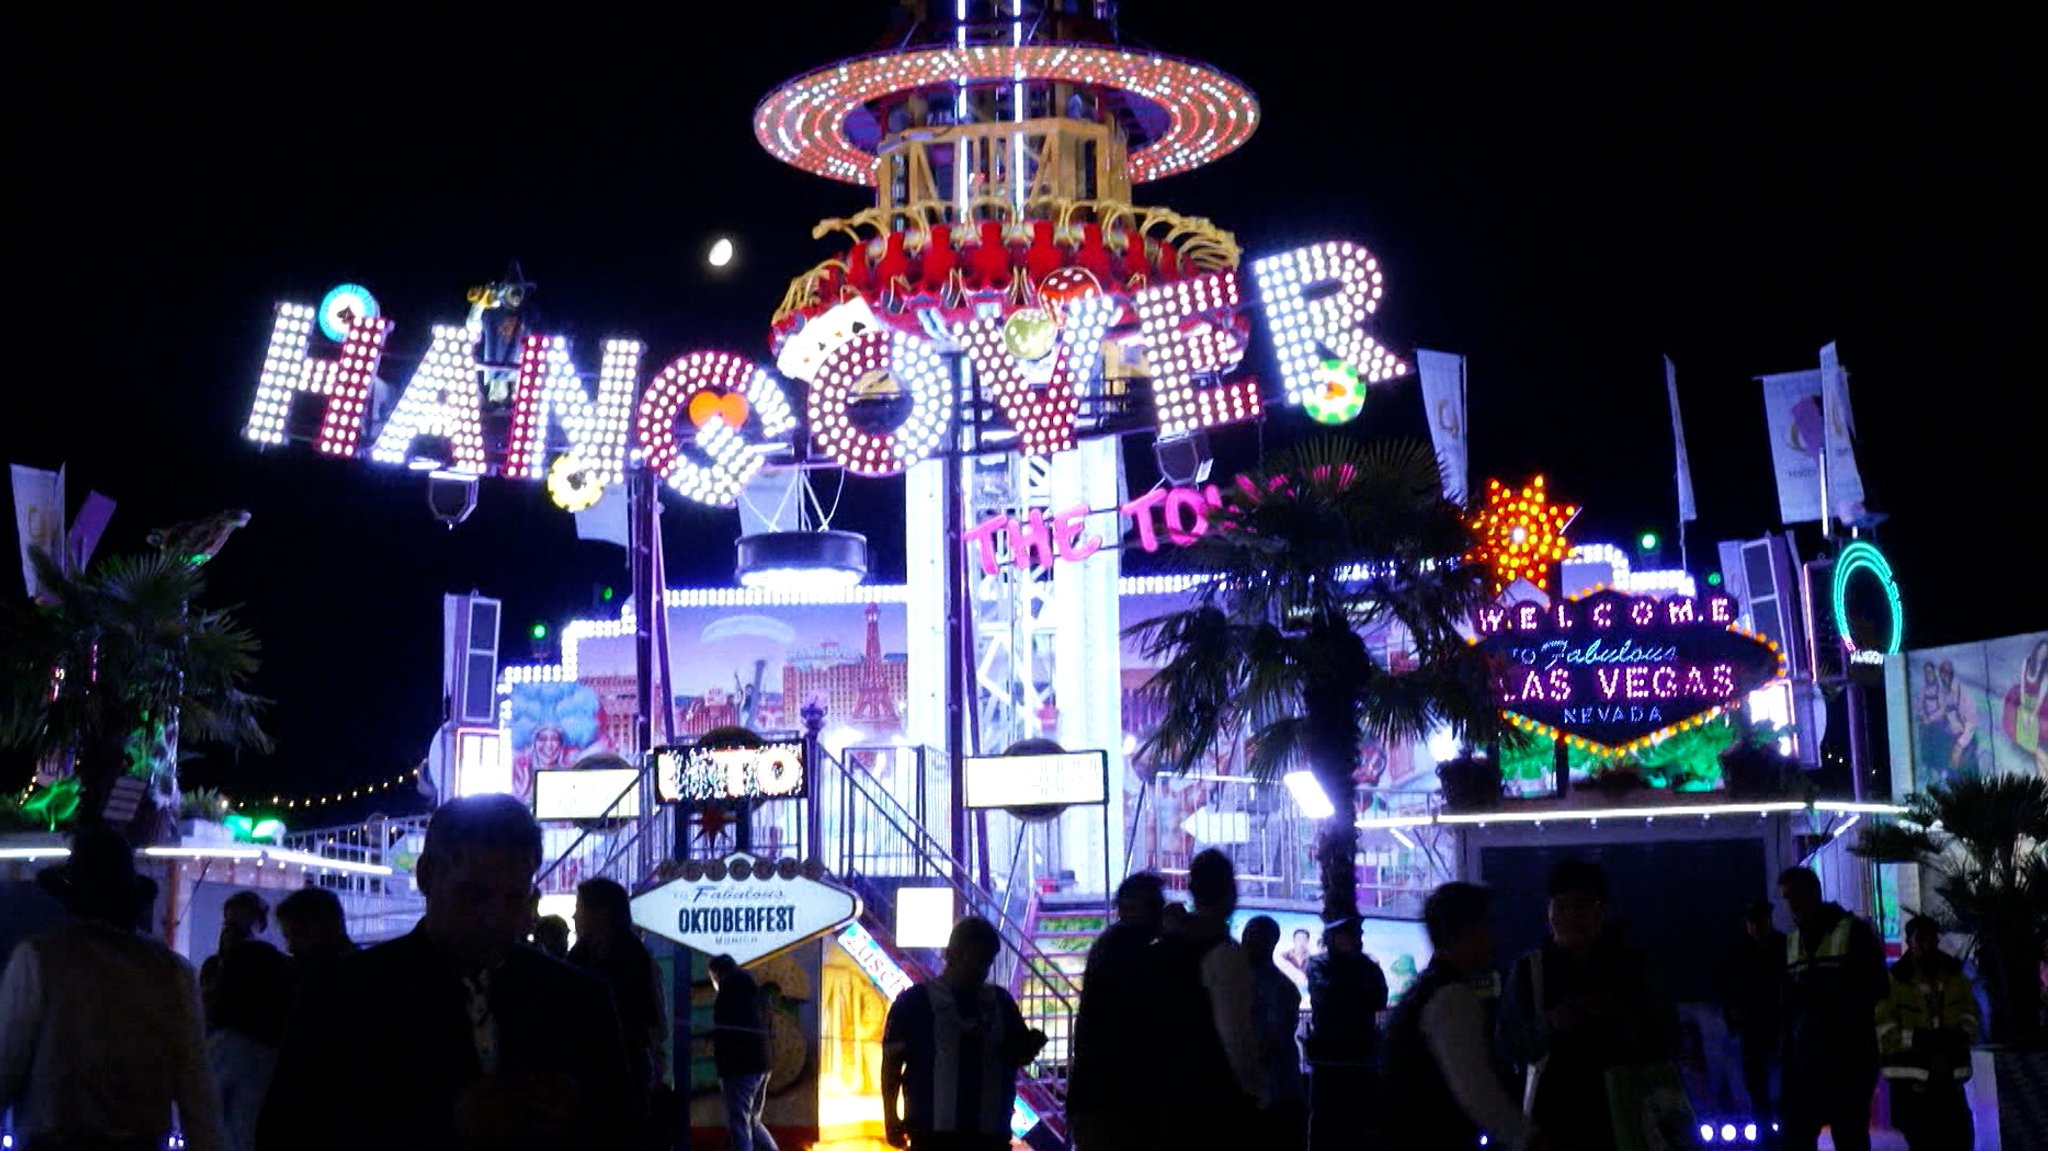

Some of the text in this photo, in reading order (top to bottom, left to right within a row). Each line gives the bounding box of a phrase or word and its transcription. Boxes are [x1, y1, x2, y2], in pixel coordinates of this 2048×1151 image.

[241, 240, 1413, 508] HANGOVER
[964, 505, 1102, 575] THE
[1479, 598, 1731, 631] WELCOME
[1541, 639, 1678, 670] Fabulous
[1598, 664, 1734, 699] VEGAS
[1564, 705, 1662, 724] NEVADA
[678, 905, 796, 934] OKTOBERFEST
